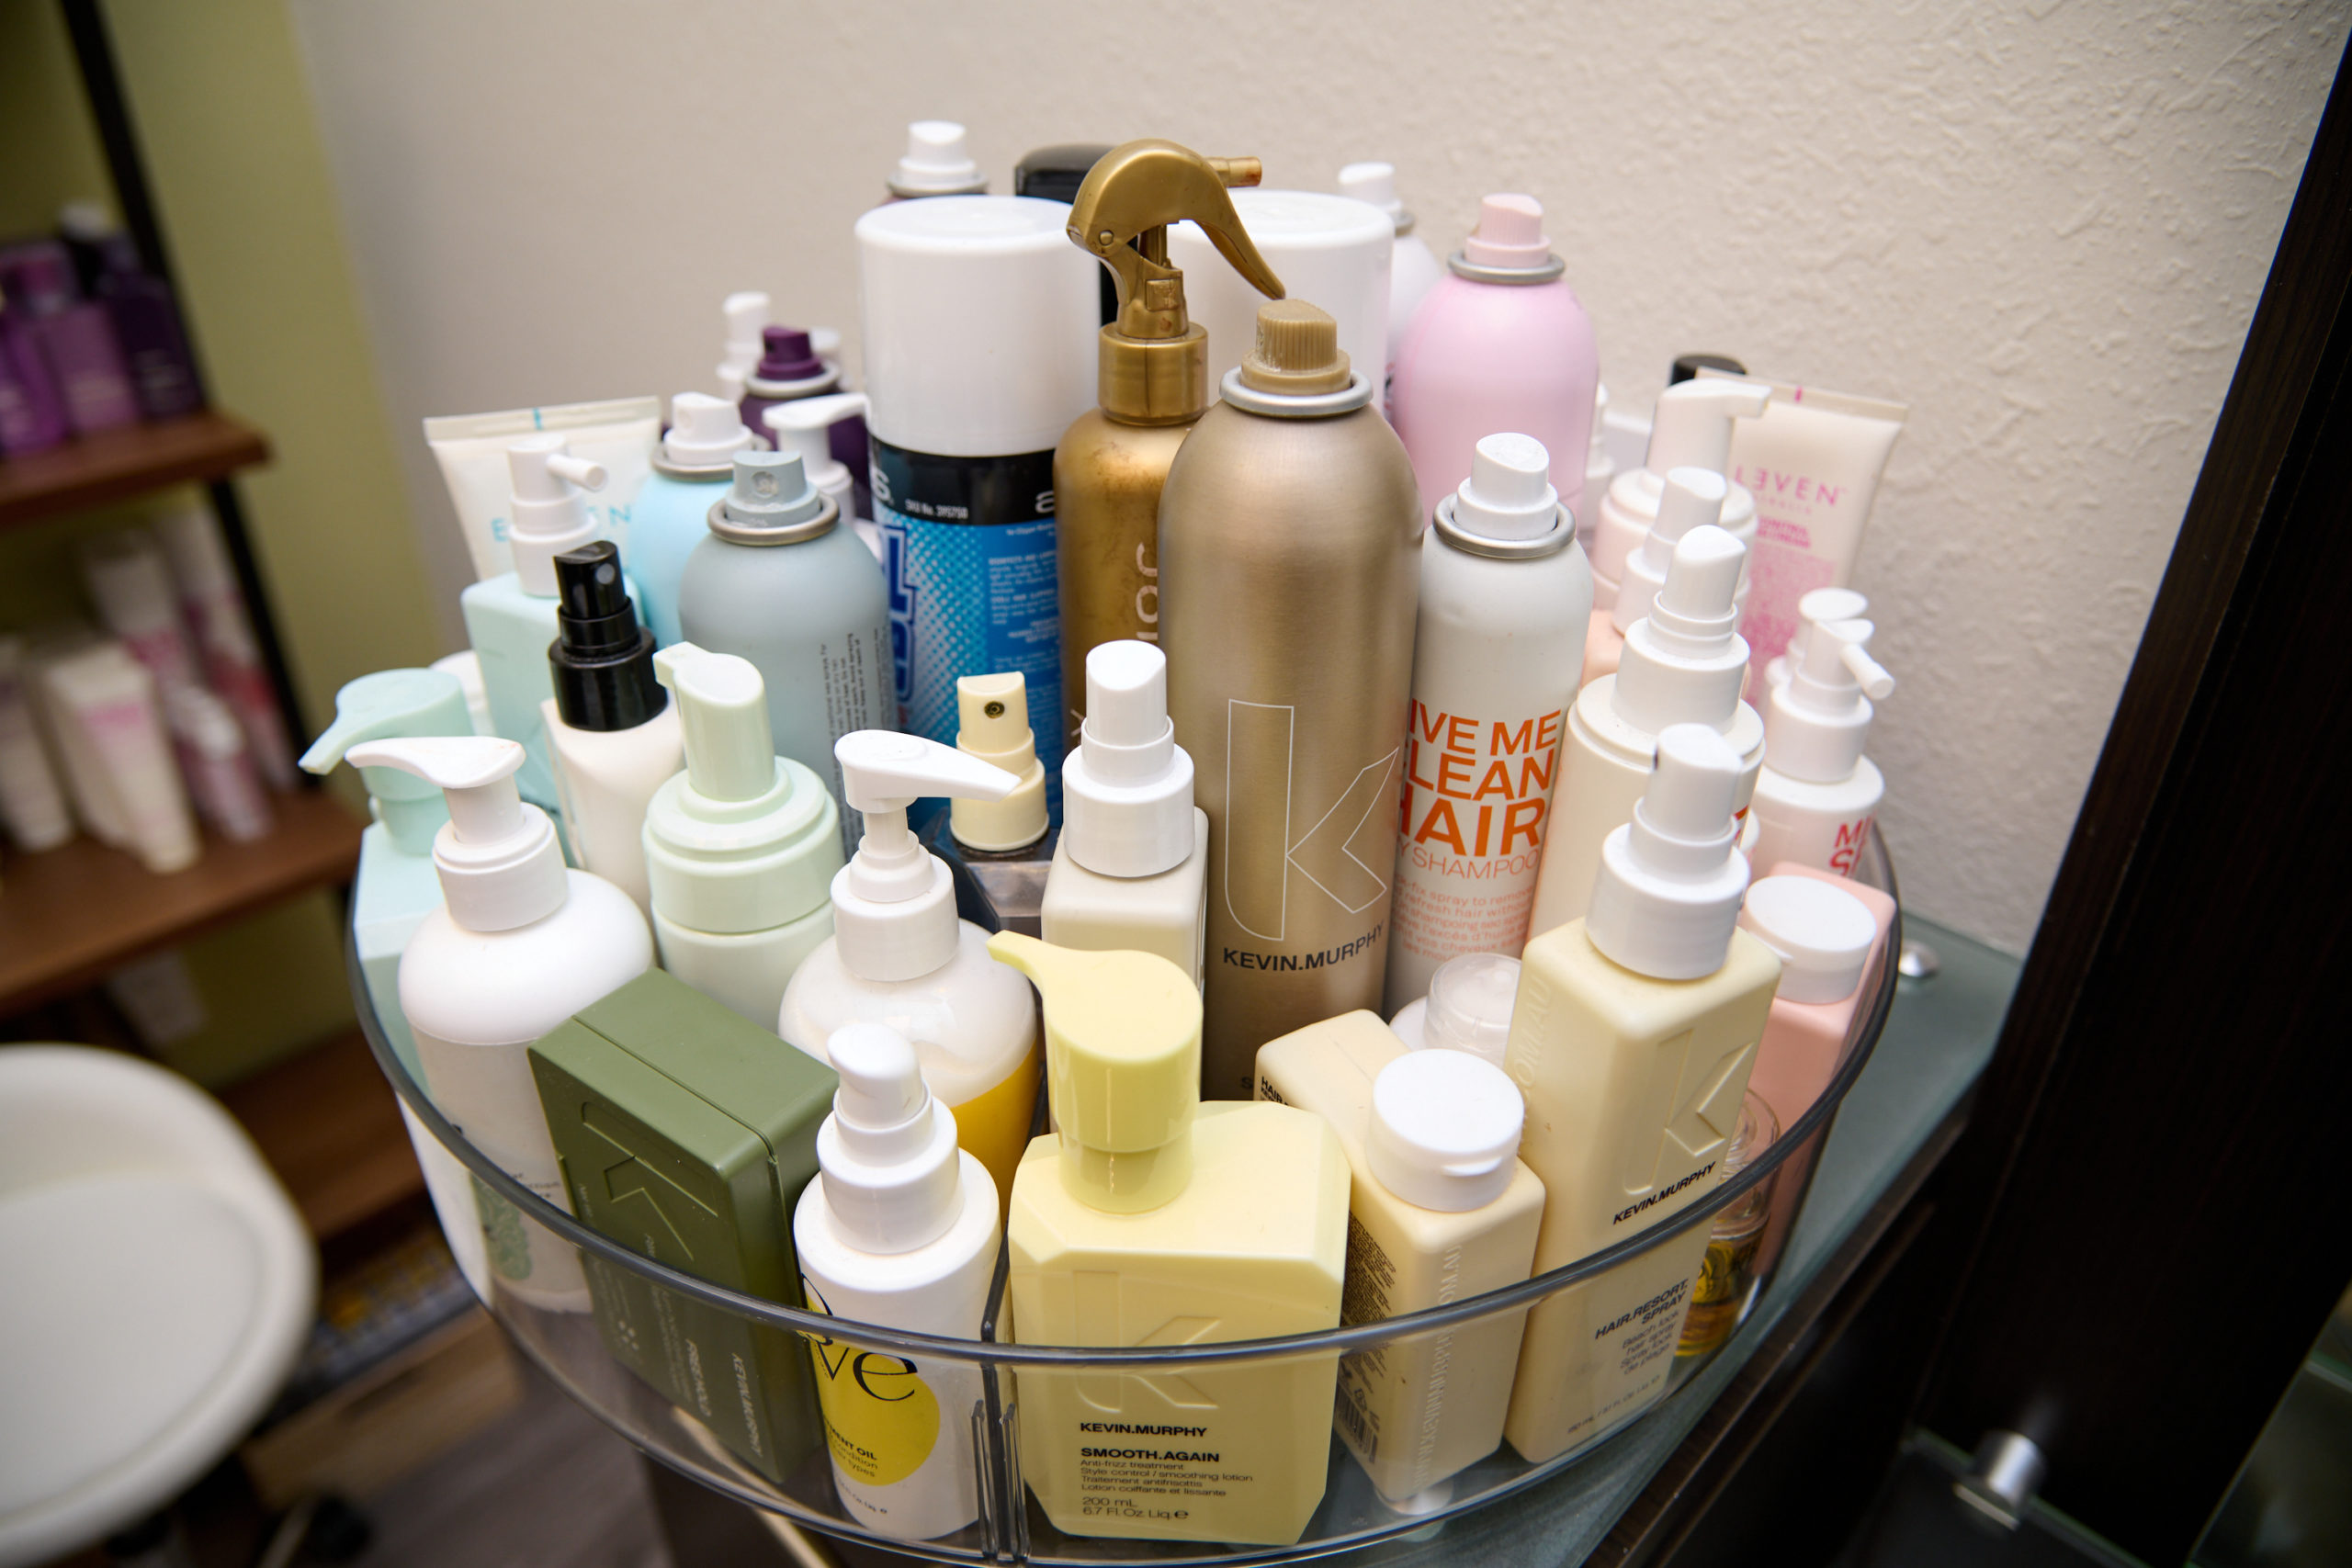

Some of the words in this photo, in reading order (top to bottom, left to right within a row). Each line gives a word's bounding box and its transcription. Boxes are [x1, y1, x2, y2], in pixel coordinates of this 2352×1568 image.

[1408, 698, 1479, 755] IVE
[1489, 709, 1562, 757] ME
[1404, 739, 1555, 802] LEAN
[1411, 844, 1540, 880] SHAMPOO
[1430, 889, 1469, 908] spray
[1472, 897, 1487, 906] to
[1455, 905, 1482, 918] hair
[1223, 919, 1385, 972] KEVIN.MURPHY
[1612, 1161, 1716, 1225] KEVIN.MURPHY
[1641, 1291, 1686, 1325] SPRAY
[1080, 1422, 1207, 1438] KEVIN.MURPHY
[856, 1447, 877, 1461] OIL
[1080, 1447, 1220, 1462] SMOOTH.AGAIN
[1080, 1460, 1127, 1469] Anti-frizz
[1129, 1461, 1184, 1471] treatment
[1080, 1467, 1108, 1478] Style
[1110, 1469, 1150, 1478] control
[1158, 1471, 1219, 1482] smoothing
[1222, 1472, 1253, 1482] lotion
[1081, 1475, 1139, 1485] Traitement
[1081, 1483, 1116, 1493] Lotion
[1118, 1485, 1167, 1495] coiffante
[1183, 1488, 1227, 1497] lissante
[1082, 1496, 1111, 1506] 200
[1114, 1498, 1137, 1507] mL
[1082, 1506, 1102, 1516] 6.7
